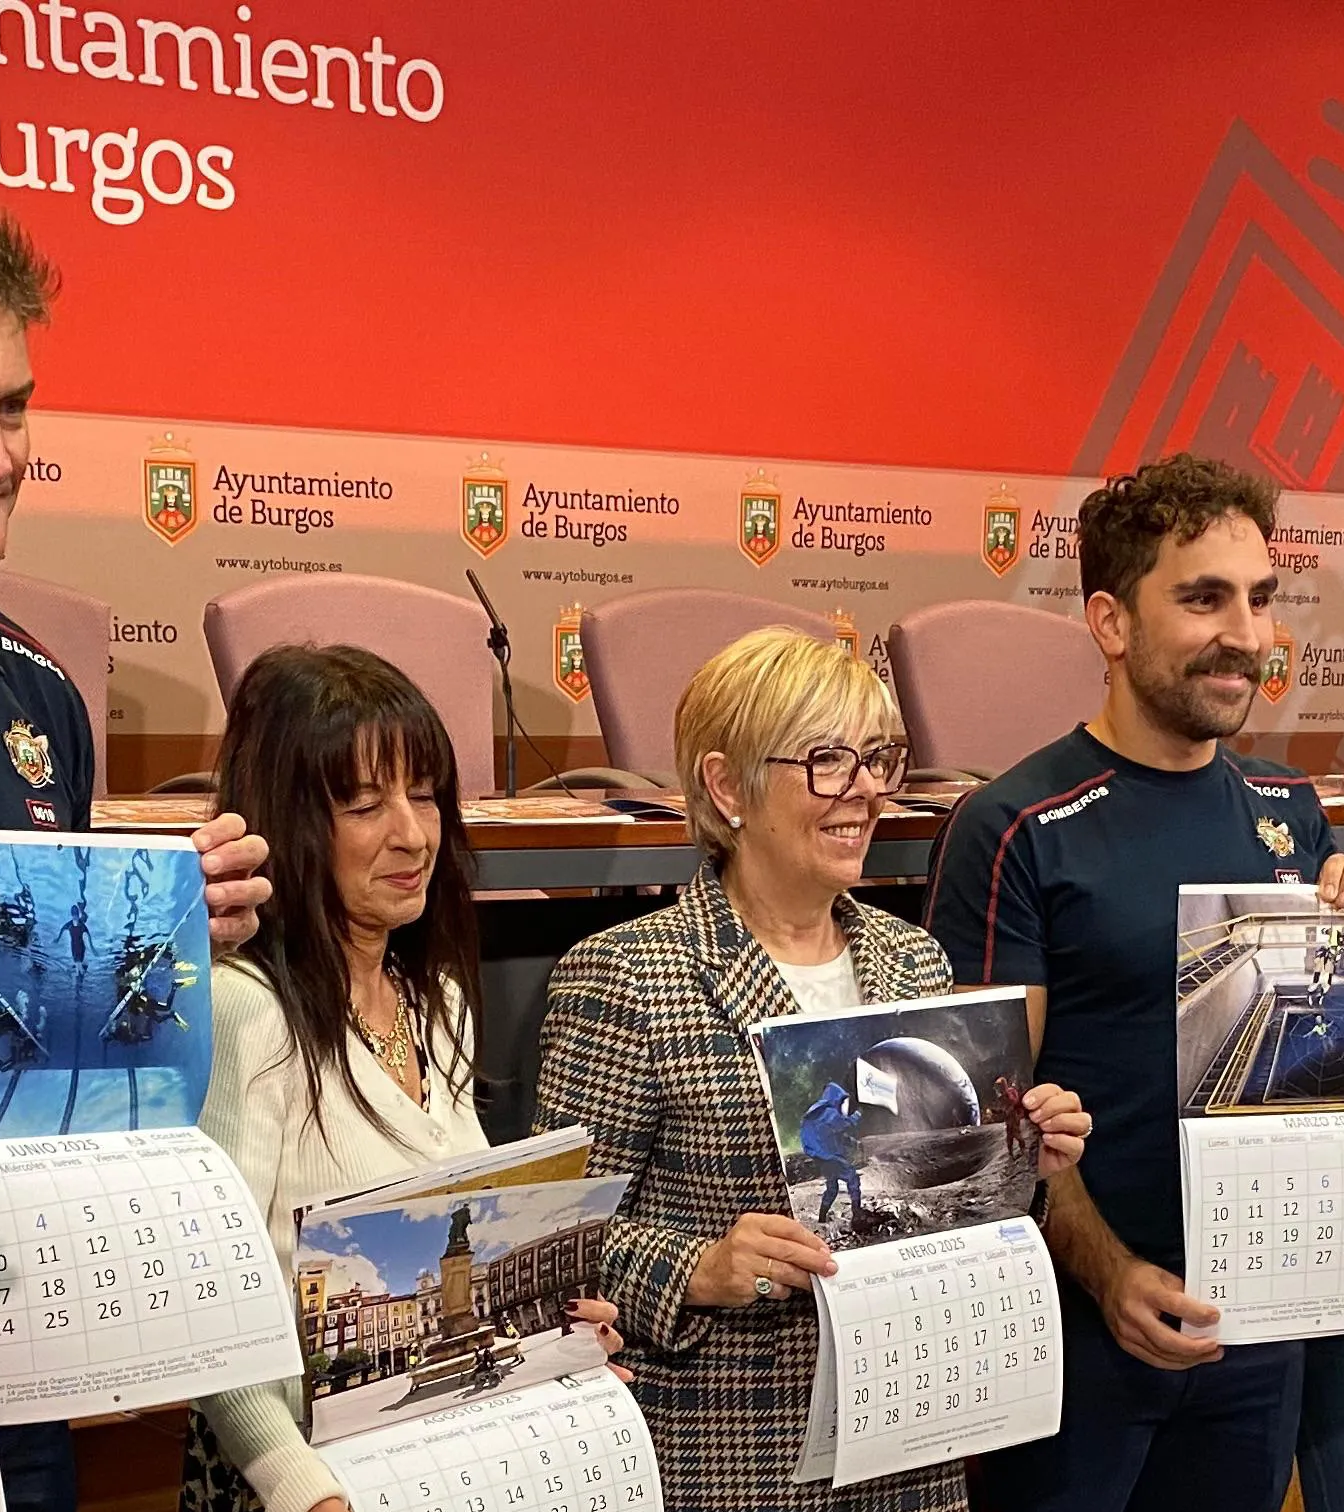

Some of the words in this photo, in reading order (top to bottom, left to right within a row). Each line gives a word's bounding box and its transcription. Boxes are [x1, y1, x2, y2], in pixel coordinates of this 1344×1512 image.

[213, 464, 393, 500] Ayuntamiento
[522, 482, 679, 515] Ayuntamiento
[793, 496, 932, 526] Ayuntamiento
[213, 495, 243, 524] de
[250, 499, 334, 534] Burgos
[521, 511, 548, 538] de
[555, 514, 627, 547] Burgos
[791, 523, 814, 548] de
[821, 526, 885, 556] Burgos
[1029, 535, 1050, 558] de
[215, 557, 342, 574] www.aytoburgos.es
[1268, 547, 1319, 574] Burgos
[522, 568, 633, 586] www.aytoburgos.es
[792, 577, 889, 593] www.aytoburgos.es
[1299, 667, 1318, 687] de
[1038, 785, 1109, 825] BOMBEROS
[1282, 1116, 1329, 1130] MARZO
[6, 1140, 56, 1159] JUNIO
[58, 1138, 100, 1153] 2025
[1212, 1207, 1229, 1222] 10
[1248, 1204, 1264, 1219] 11
[1283, 1201, 1299, 1217] 12
[1318, 1199, 1334, 1214] 13
[36, 1244, 61, 1265] 11
[86, 1235, 110, 1255] 12
[134, 1226, 156, 1246] 13
[178, 1218, 201, 1238] 14
[221, 1211, 243, 1230] 15
[898, 1243, 937, 1262] ENERO
[938, 1236, 966, 1253] 2025
[44, 1309, 69, 1330] 25
[97, 1299, 122, 1320] 26
[147, 1289, 169, 1310] 27
[195, 1280, 218, 1301] 28
[239, 1271, 262, 1291] 29
[854, 1387, 869, 1406] 20
[885, 1380, 900, 1398] 21
[915, 1373, 930, 1390] 22
[946, 1365, 960, 1383] 23
[975, 1358, 990, 1376] 24
[1004, 1351, 1018, 1369] 25
[1033, 1344, 1047, 1362] 26
[422, 1401, 484, 1427] AGOSTO
[487, 1393, 523, 1412] 2025
[379, 1492, 390, 1507] 4
[419, 1481, 431, 1497] 5
[460, 1470, 471, 1486] 6
[499, 1460, 508, 1475] 7
[539, 1450, 551, 1465] 8
[578, 1440, 589, 1455] 9
[612, 1428, 632, 1446] 10
